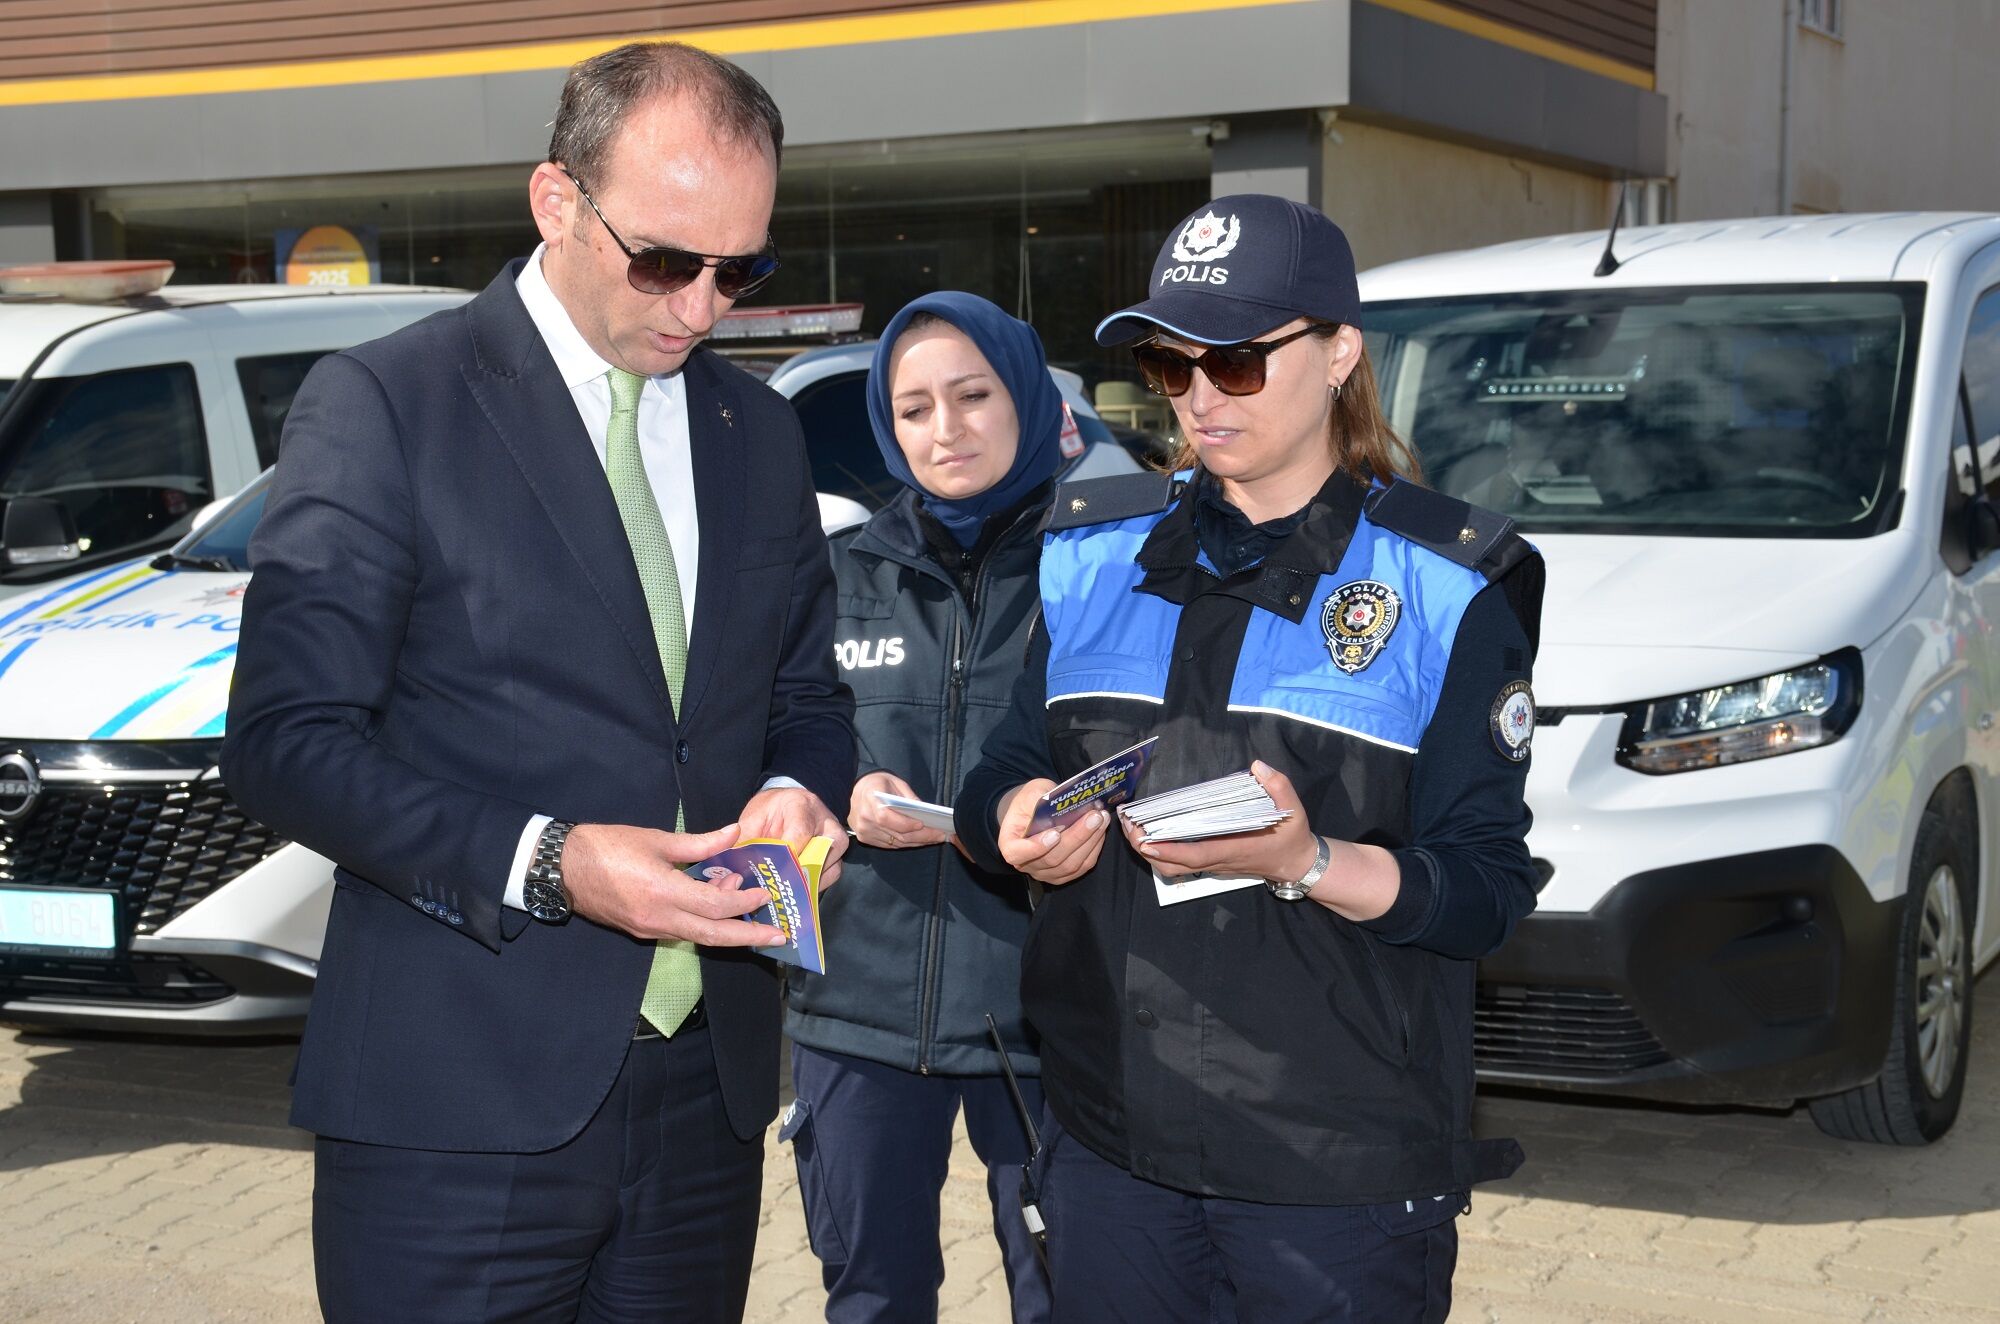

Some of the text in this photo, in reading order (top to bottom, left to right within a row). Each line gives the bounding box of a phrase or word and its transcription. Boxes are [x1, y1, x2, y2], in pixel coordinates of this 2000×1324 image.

[1050, 762, 1135, 806] KURALLARINA
[1056, 771, 1126, 811] UYALIM
[757, 863, 791, 939] UYALIM
[763, 857, 798, 949] KURALLARINA
